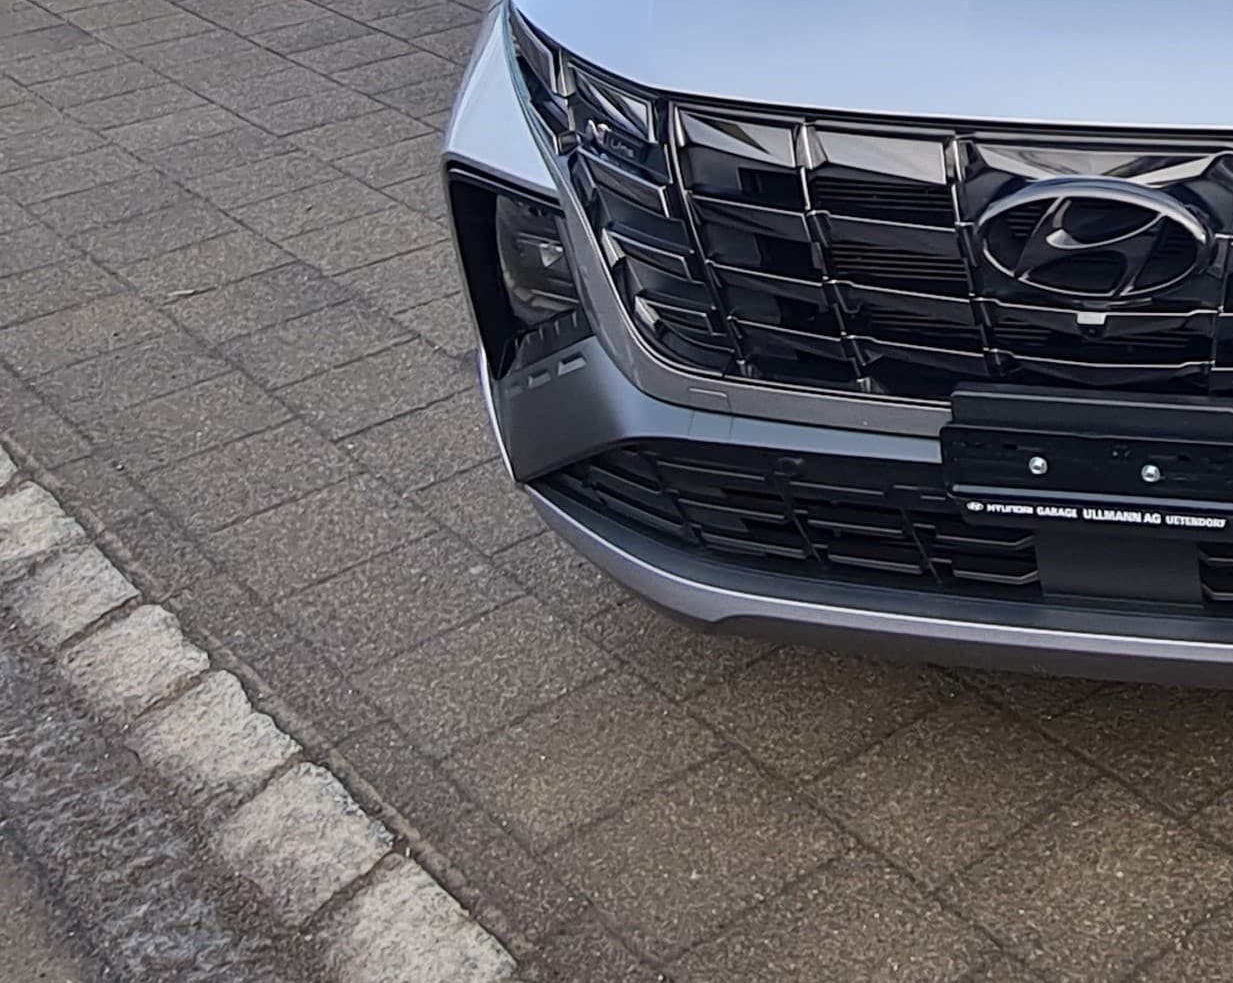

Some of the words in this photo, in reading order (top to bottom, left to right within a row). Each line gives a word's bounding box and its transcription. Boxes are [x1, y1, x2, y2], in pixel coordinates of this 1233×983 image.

[986, 503, 1034, 514] HYUNDAI
[1036, 505, 1078, 518] GARAGE
[1082, 508, 1142, 523] ULLMANN
[1143, 512, 1162, 524] AG
[1165, 515, 1226, 528] UETENDORF
